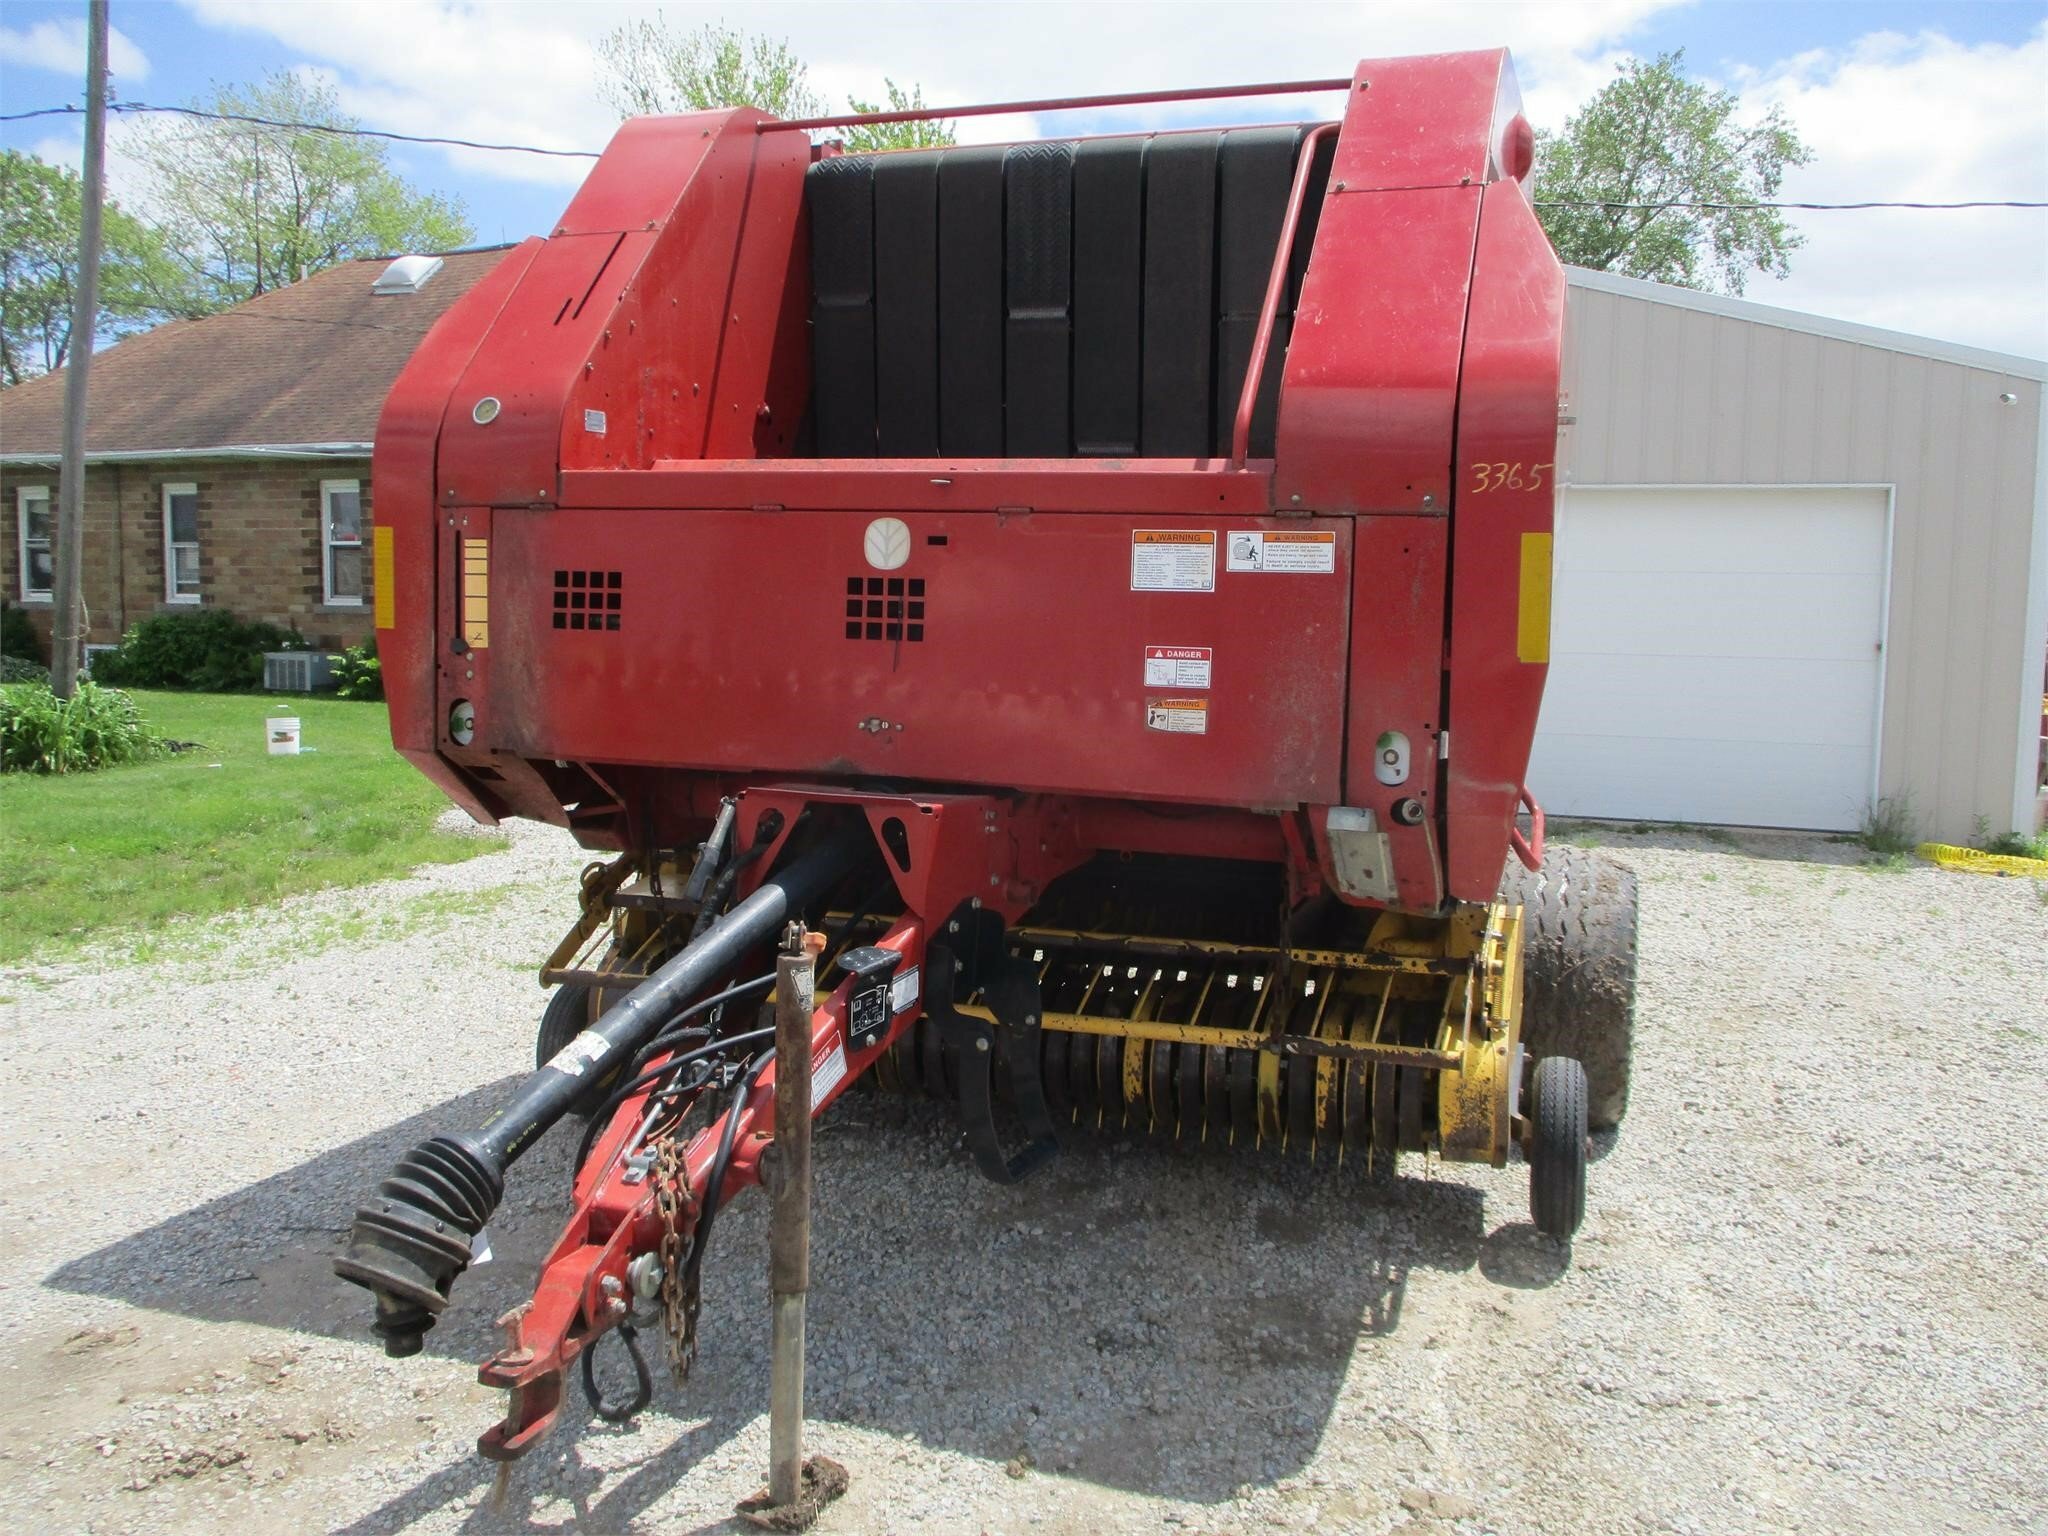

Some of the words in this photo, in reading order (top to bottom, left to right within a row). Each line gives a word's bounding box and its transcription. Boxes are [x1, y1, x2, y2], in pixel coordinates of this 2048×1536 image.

[1471, 462, 1554, 493] 3365
[1159, 534, 1201, 542] WARNING
[1167, 650, 1202, 659] DANGER
[811, 1047, 831, 1072] NGER
